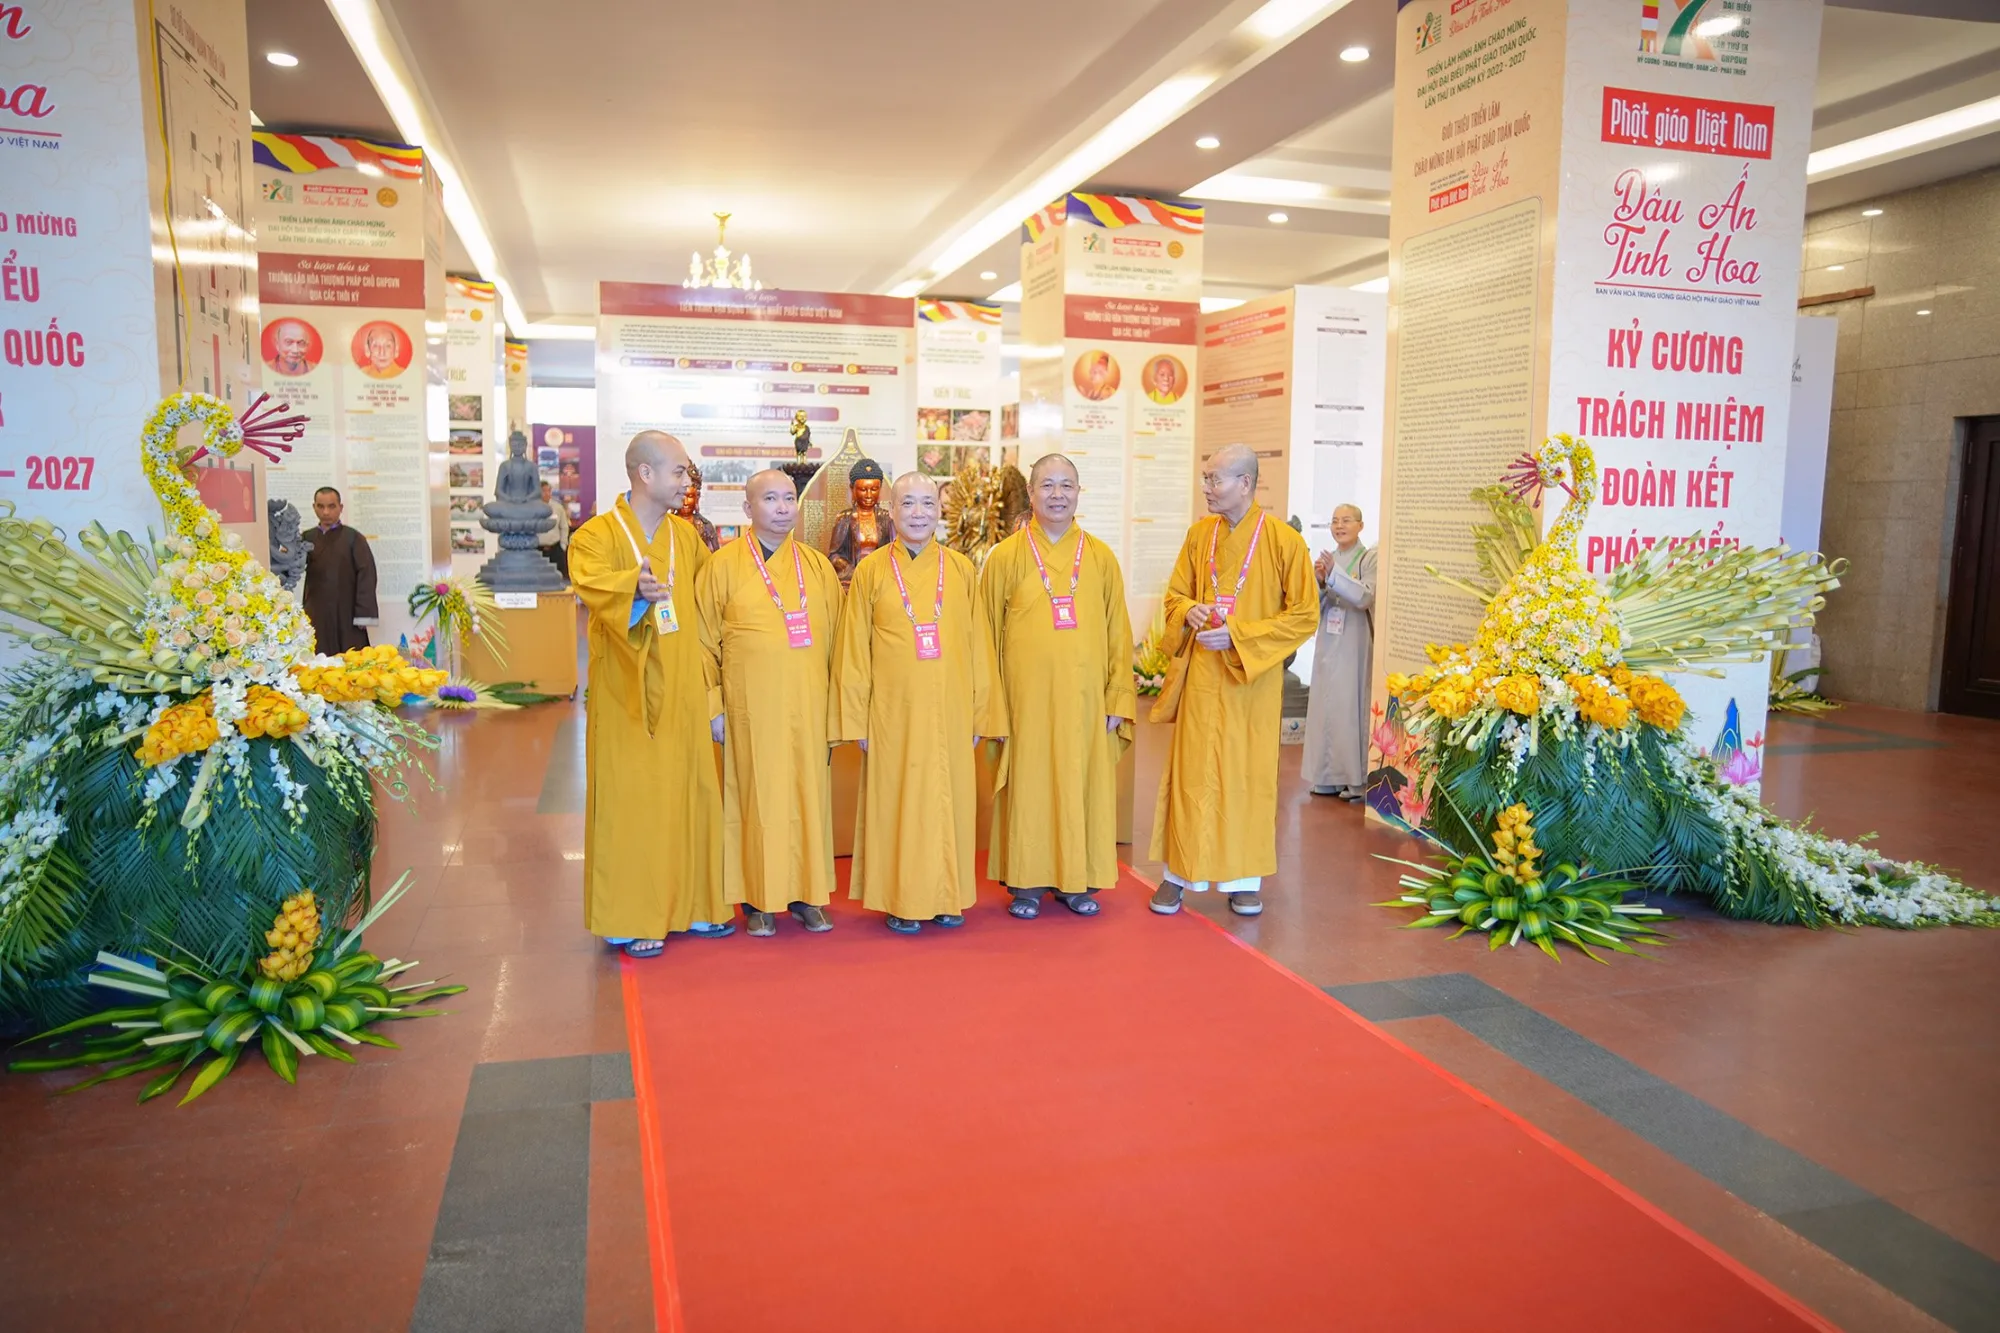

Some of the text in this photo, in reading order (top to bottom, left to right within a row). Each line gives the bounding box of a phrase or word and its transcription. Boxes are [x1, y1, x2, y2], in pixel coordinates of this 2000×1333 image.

[7, 137, 29, 149] VIỆT
[33, 140, 60, 150] NAM
[1610, 98, 1649, 144] Phật
[1654, 107, 1689, 147] giáo
[1733, 112, 1768, 152] Nam
[1697, 161, 1759, 233] Ấn
[16, 210, 77, 237] MỪNG
[1604, 222, 1761, 285] Tinh Hoa
[1745, 298, 1760, 306] NAM
[4, 317, 85, 368] QUỐC
[1607, 317, 1643, 369] KỶ
[1651, 330, 1743, 375] CƯƠNG
[1576, 390, 1765, 450] TRÁCH NHIỆM
[26, 456, 95, 490] 2027
[1601, 456, 1735, 508] ĐOÀN KẾT
